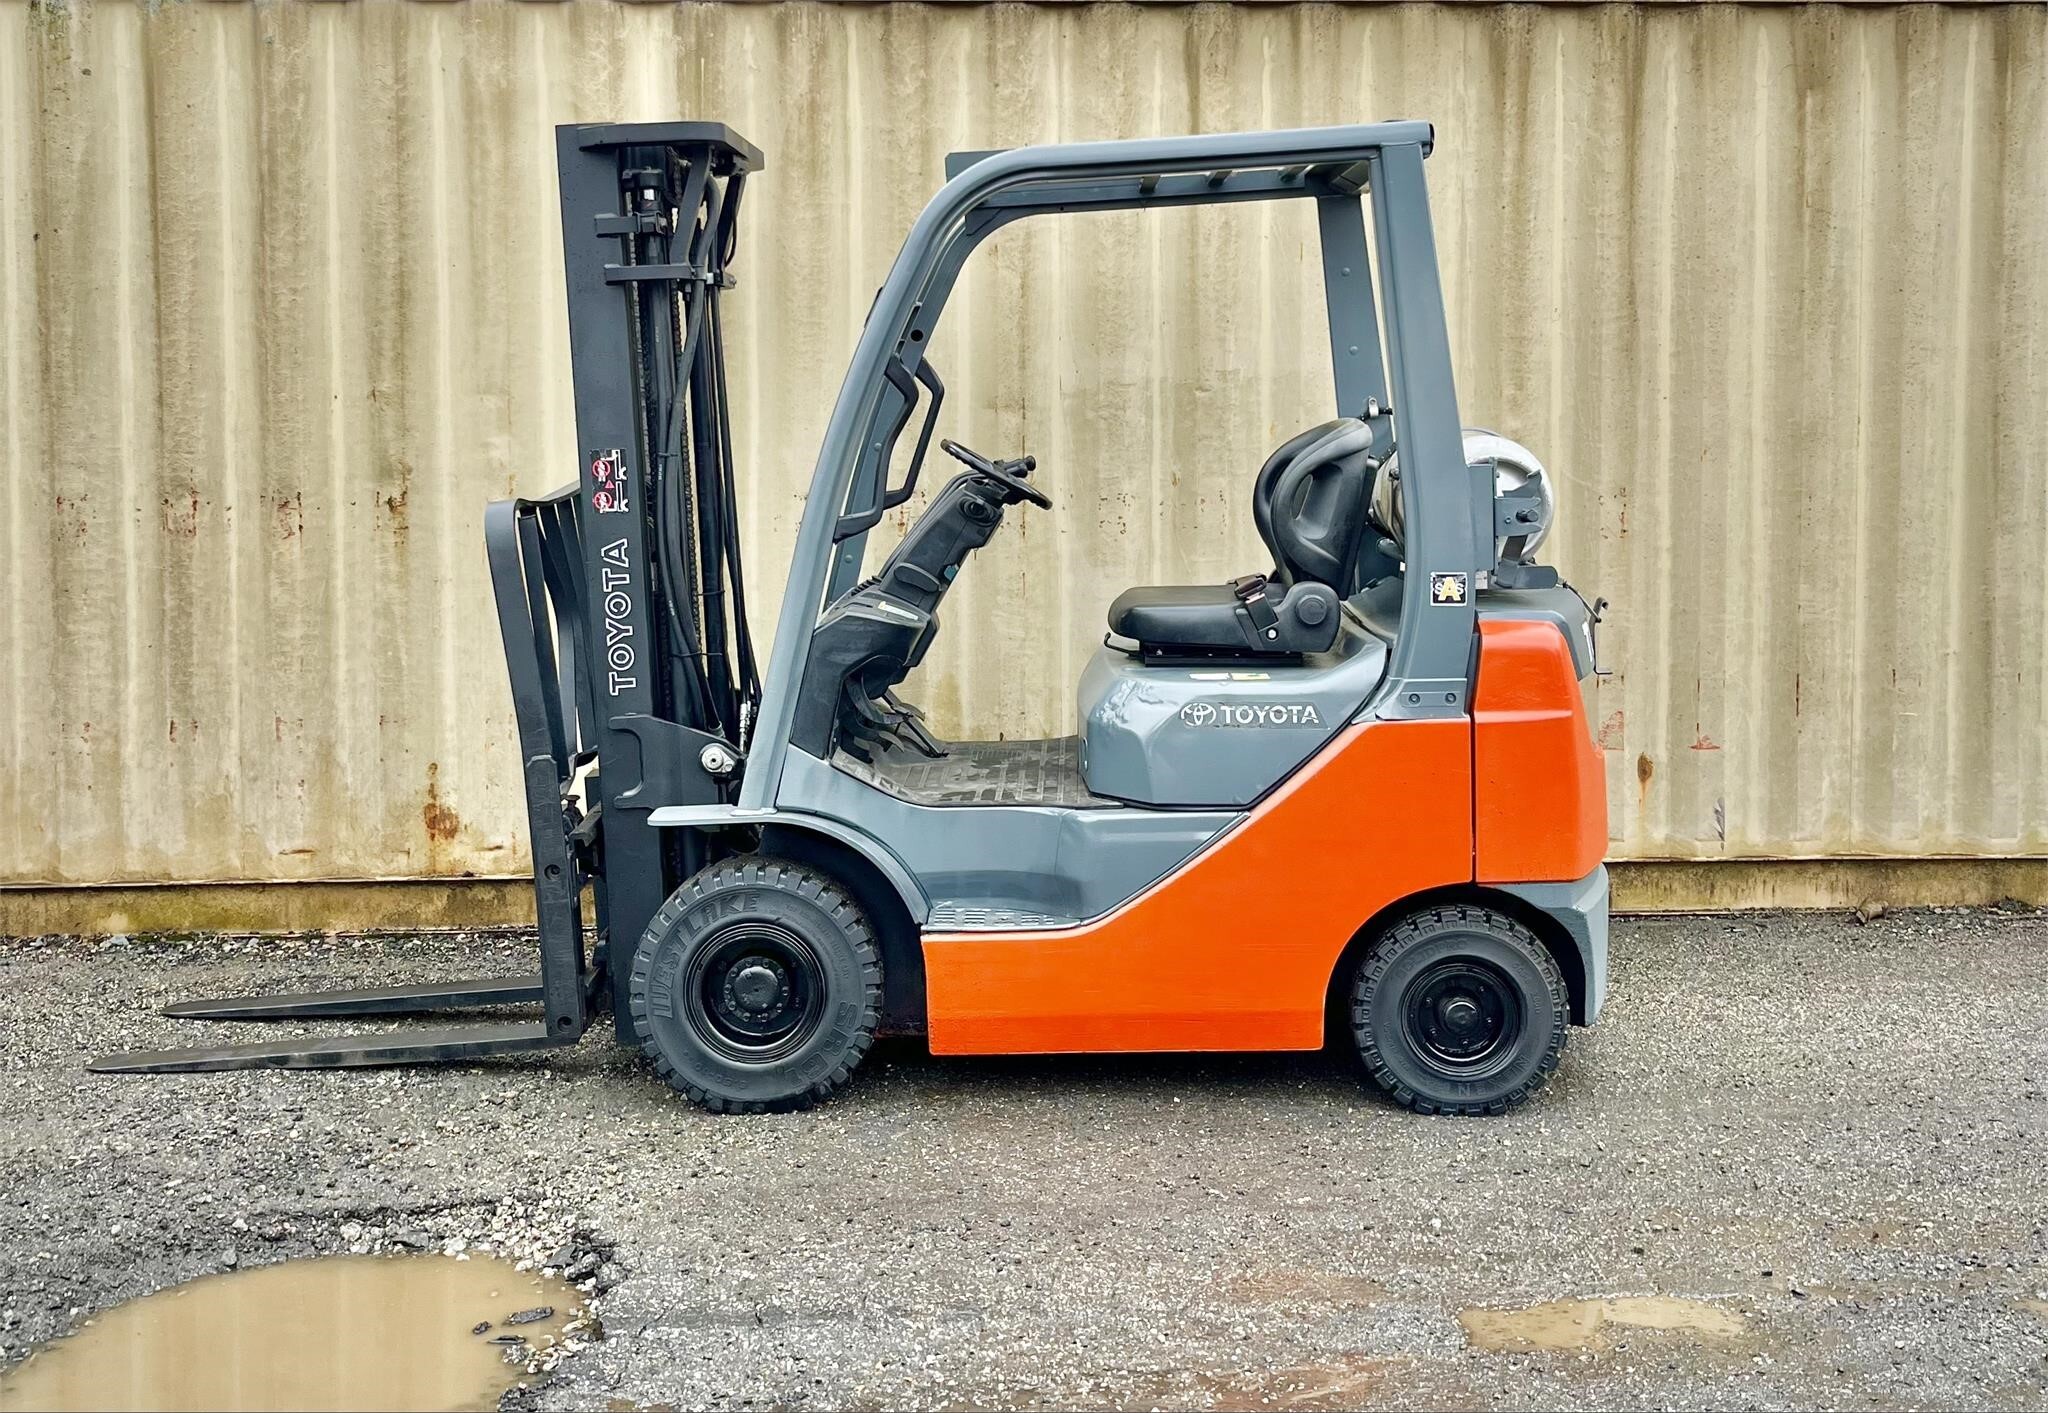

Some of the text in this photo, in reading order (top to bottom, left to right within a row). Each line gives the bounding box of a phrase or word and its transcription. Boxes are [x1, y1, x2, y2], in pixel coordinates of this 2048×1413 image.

[600, 538, 637, 696] TOYOTA
[1220, 705, 1319, 724] TOYOTA
[650, 893, 760, 1018] WESTLAKE
